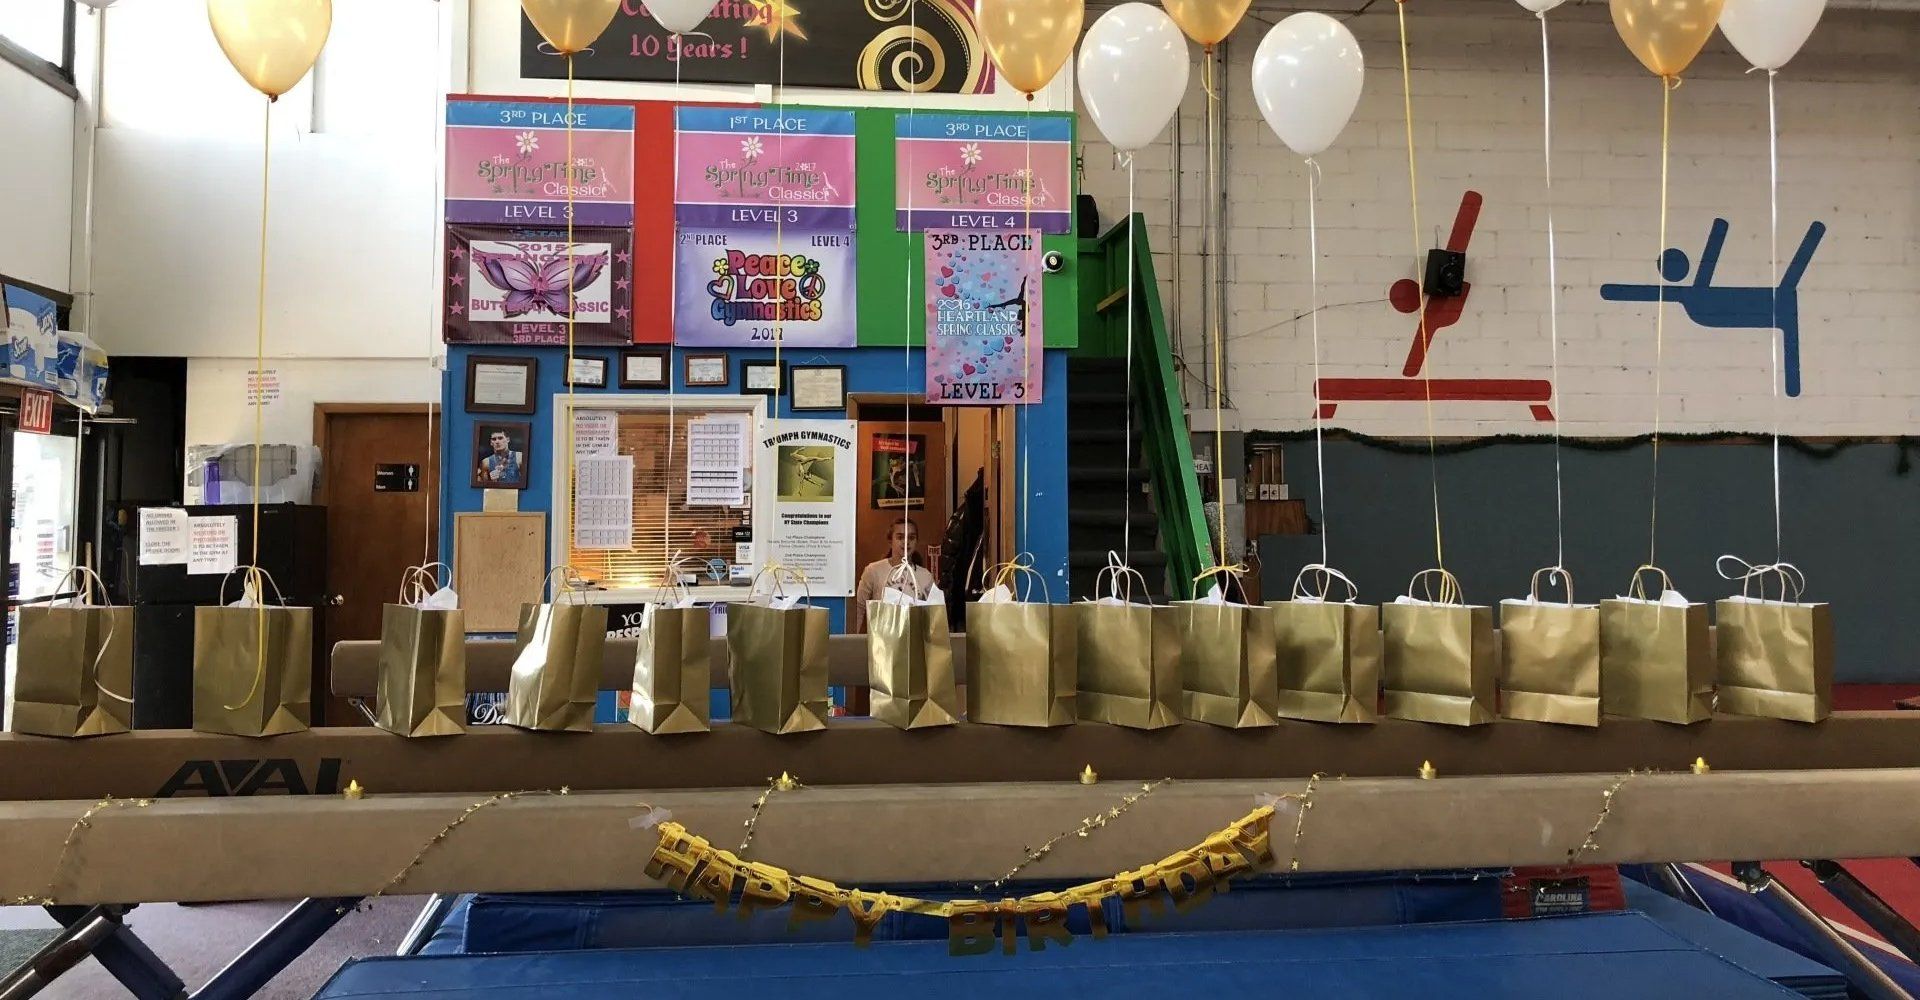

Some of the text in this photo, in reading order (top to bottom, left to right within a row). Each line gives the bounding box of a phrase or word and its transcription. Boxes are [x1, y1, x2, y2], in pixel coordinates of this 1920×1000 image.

[629, 34, 660, 57] 10
[667, 33, 733, 62] Years
[500, 110, 587, 126] 3RD PLACE
[730, 116, 807, 131] 1ST PLACE
[945, 123, 1027, 138] 3RD PLACE
[492, 154, 510, 164] The
[720, 159, 736, 169] The
[940, 165, 955, 176] The
[987, 192, 1041, 206] Classc
[505, 205, 556, 218] LEVEL
[732, 209, 798, 223] LEVEL 3
[951, 215, 1015, 228] LEVEL 4
[695, 234, 728, 246] PLACE
[811, 235, 850, 247] LEVEL 4
[932, 234, 1033, 251] 3RD PLACE
[518, 243, 566, 252] 2015
[725, 249, 807, 277] Peace
[735, 275, 798, 300] Love
[710, 298, 822, 326] Gymnastics
[937, 310, 1018, 323] HEARTLAND
[513, 323, 567, 334] LEVEL 3
[937, 323, 1018, 336] SPRING CLASSIC
[513, 335, 566, 344] 3RD PLACE
[941, 382, 1026, 399] LEVEL 3
[24, 393, 50, 429] EXIT
[801, 430, 851, 449] GYMNASTICS
[644, 821, 889, 948] HAPPY
